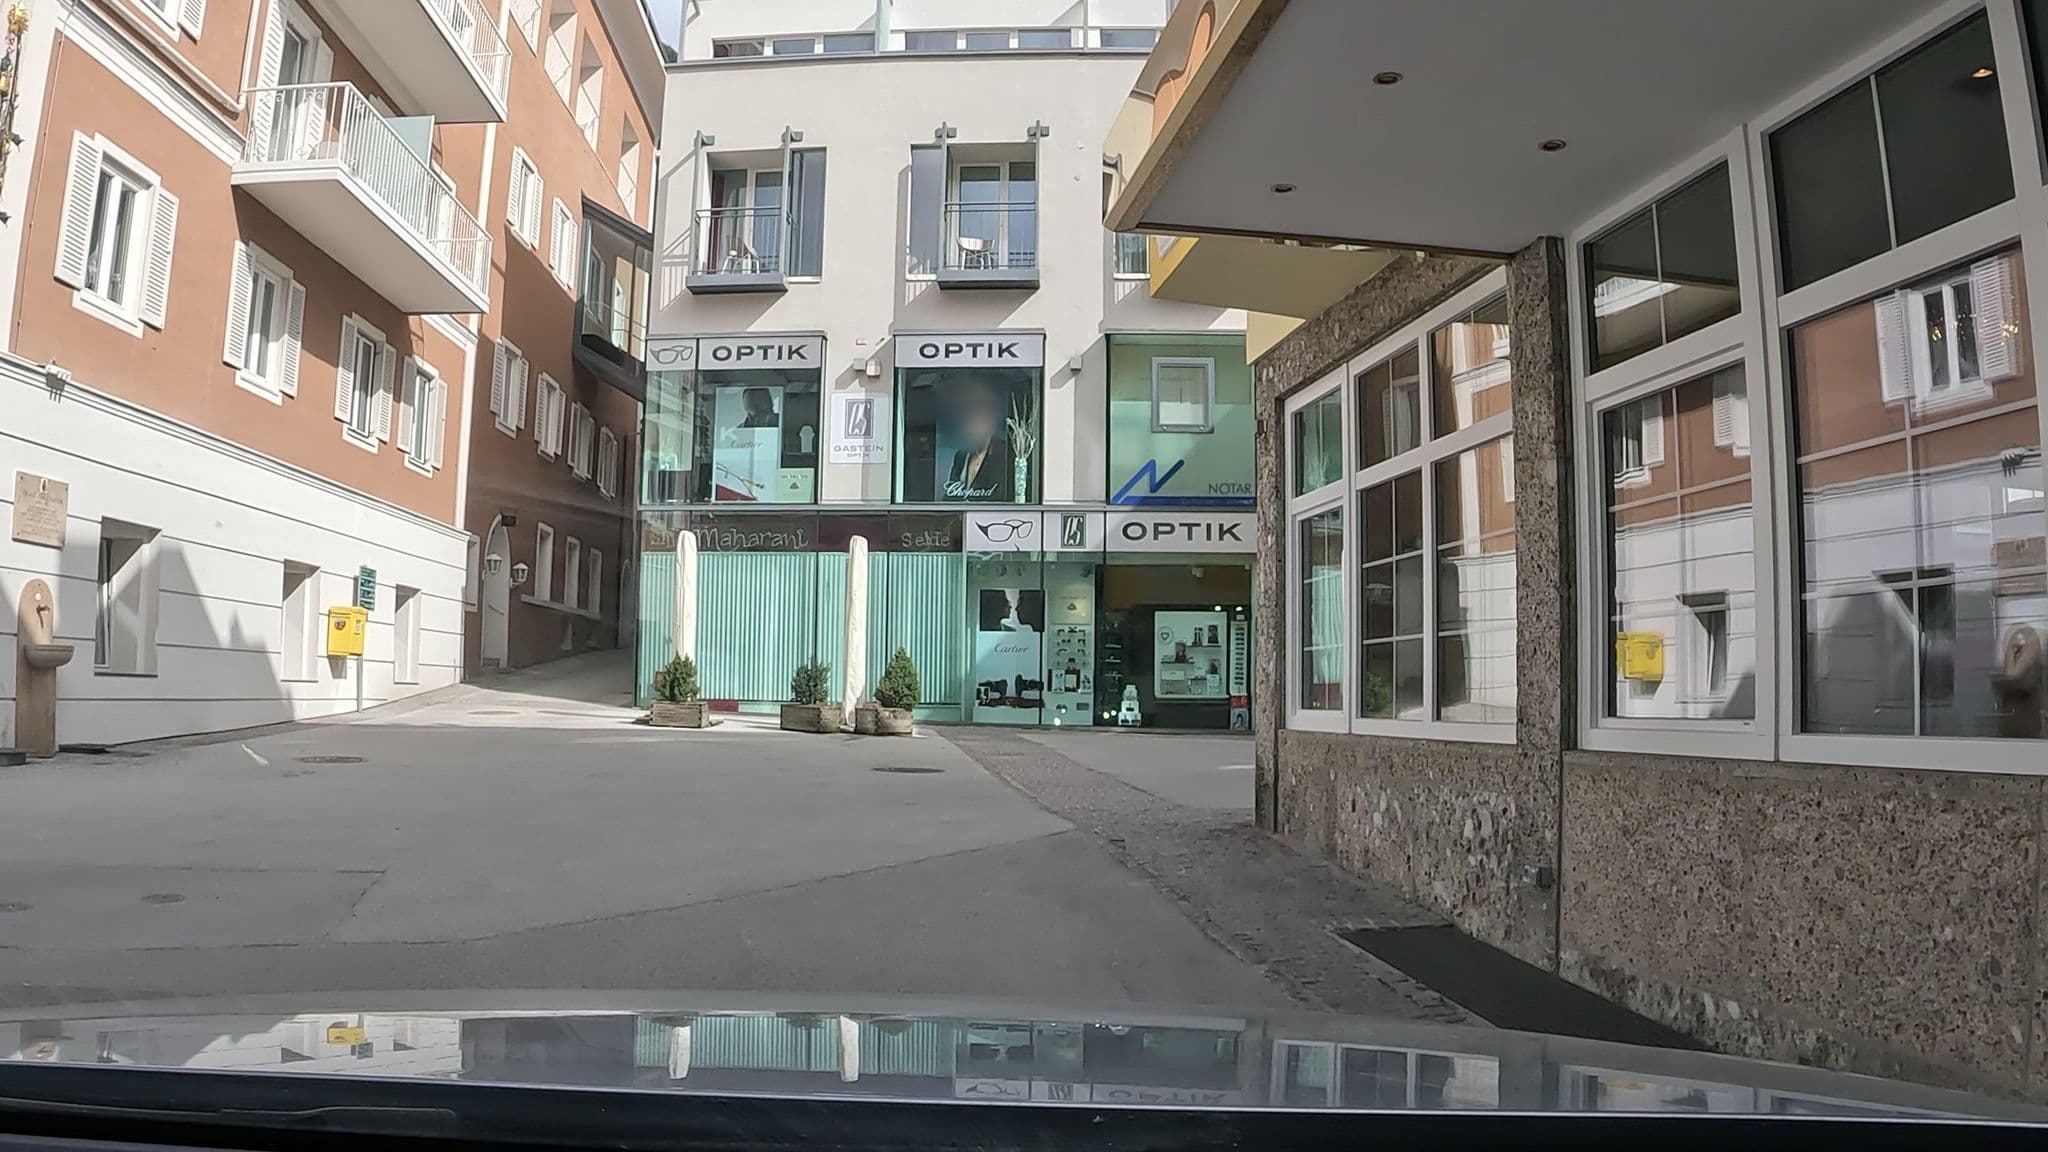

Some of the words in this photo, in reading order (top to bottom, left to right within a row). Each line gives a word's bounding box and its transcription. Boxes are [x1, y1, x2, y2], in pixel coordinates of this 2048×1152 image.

[711, 344, 808, 362] OPTIK
[919, 342, 1020, 359] OPTIK
[943, 480, 999, 498] Chopard
[1208, 482, 1252, 495] NOTAR
[694, 527, 809, 551] Maharani
[1121, 521, 1243, 542] OPTIK
[994, 642, 1028, 654] Cartier
